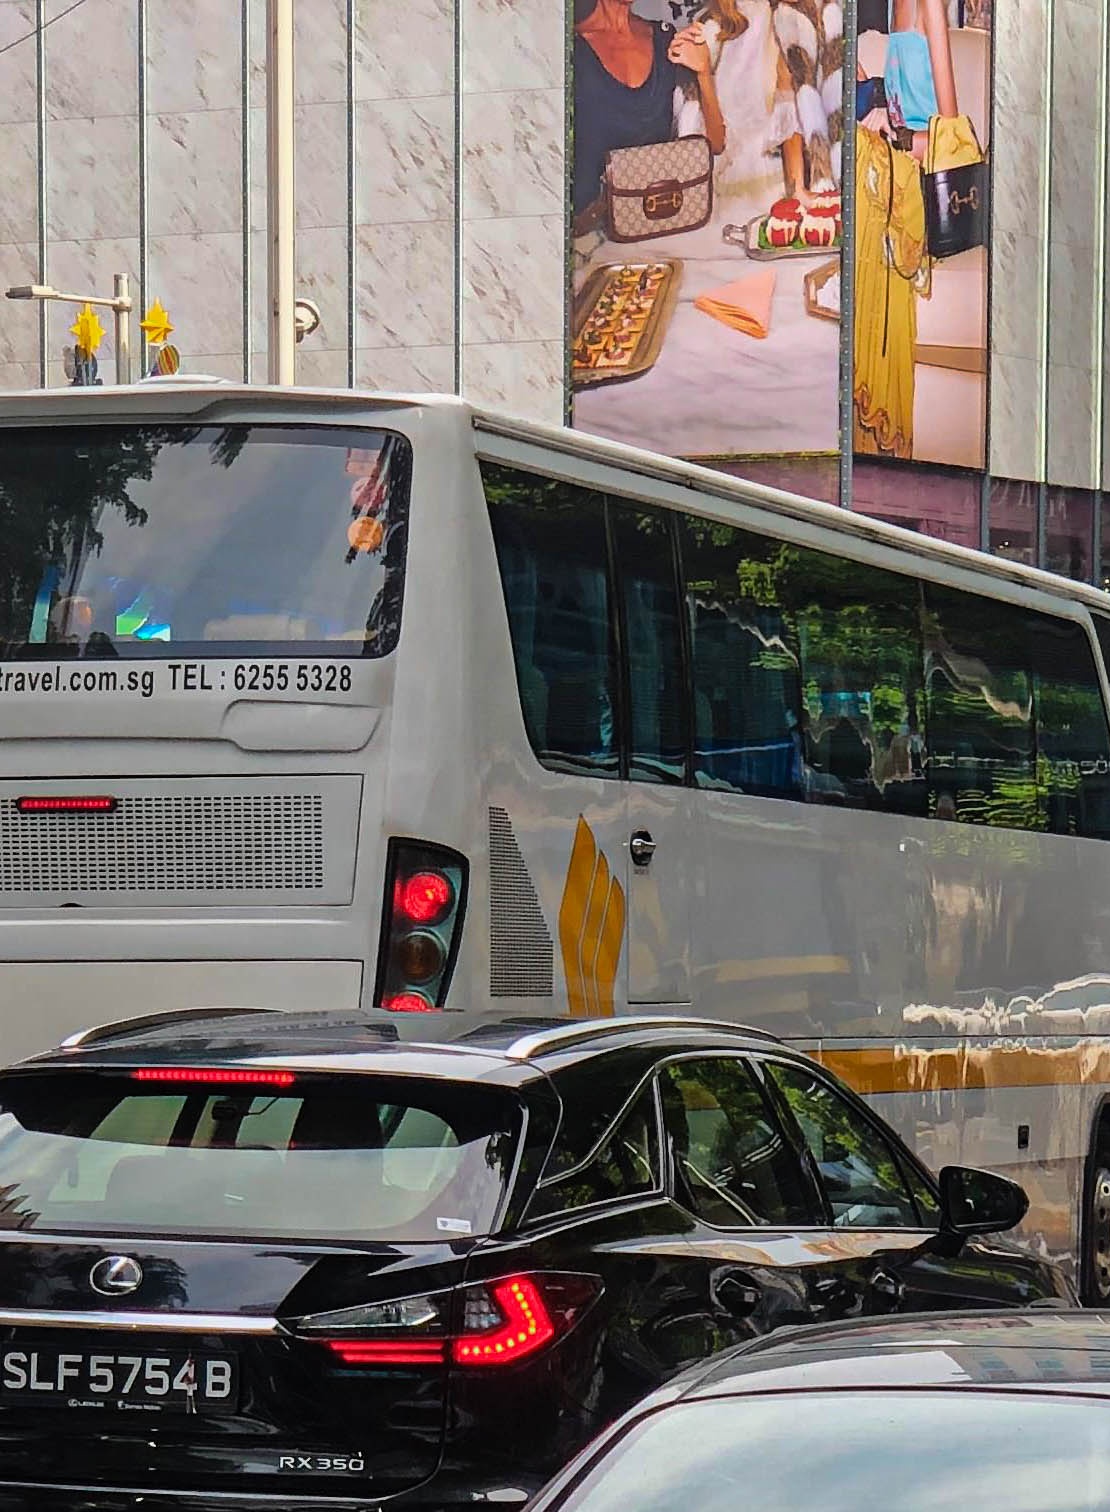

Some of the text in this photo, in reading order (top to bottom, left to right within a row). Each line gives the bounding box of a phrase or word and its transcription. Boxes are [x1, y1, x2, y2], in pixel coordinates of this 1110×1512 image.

[168, 664, 213, 691] TEL
[233, 664, 289, 691] 6255
[296, 664, 352, 692] 5328
[3, 1352, 82, 1391] SLF
[280, 1456, 364, 1471] RX 350
